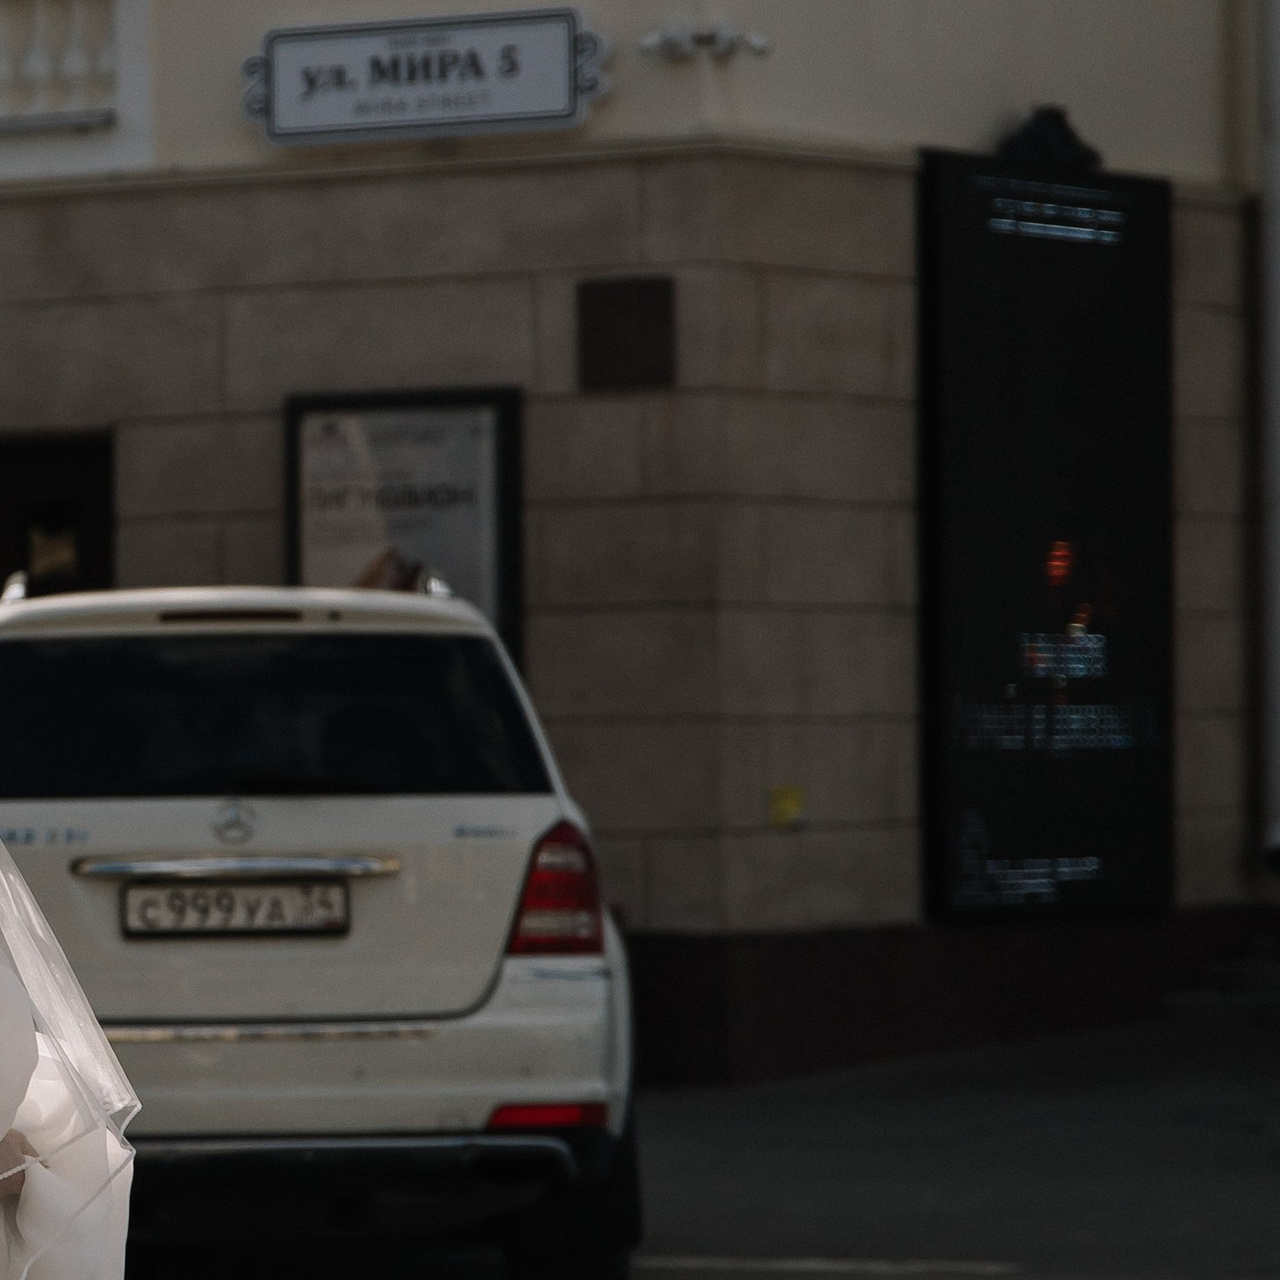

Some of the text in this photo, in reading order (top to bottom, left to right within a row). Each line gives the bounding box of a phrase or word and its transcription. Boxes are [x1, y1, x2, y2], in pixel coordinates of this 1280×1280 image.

[301, 44, 521, 102] ул. МИРА 5
